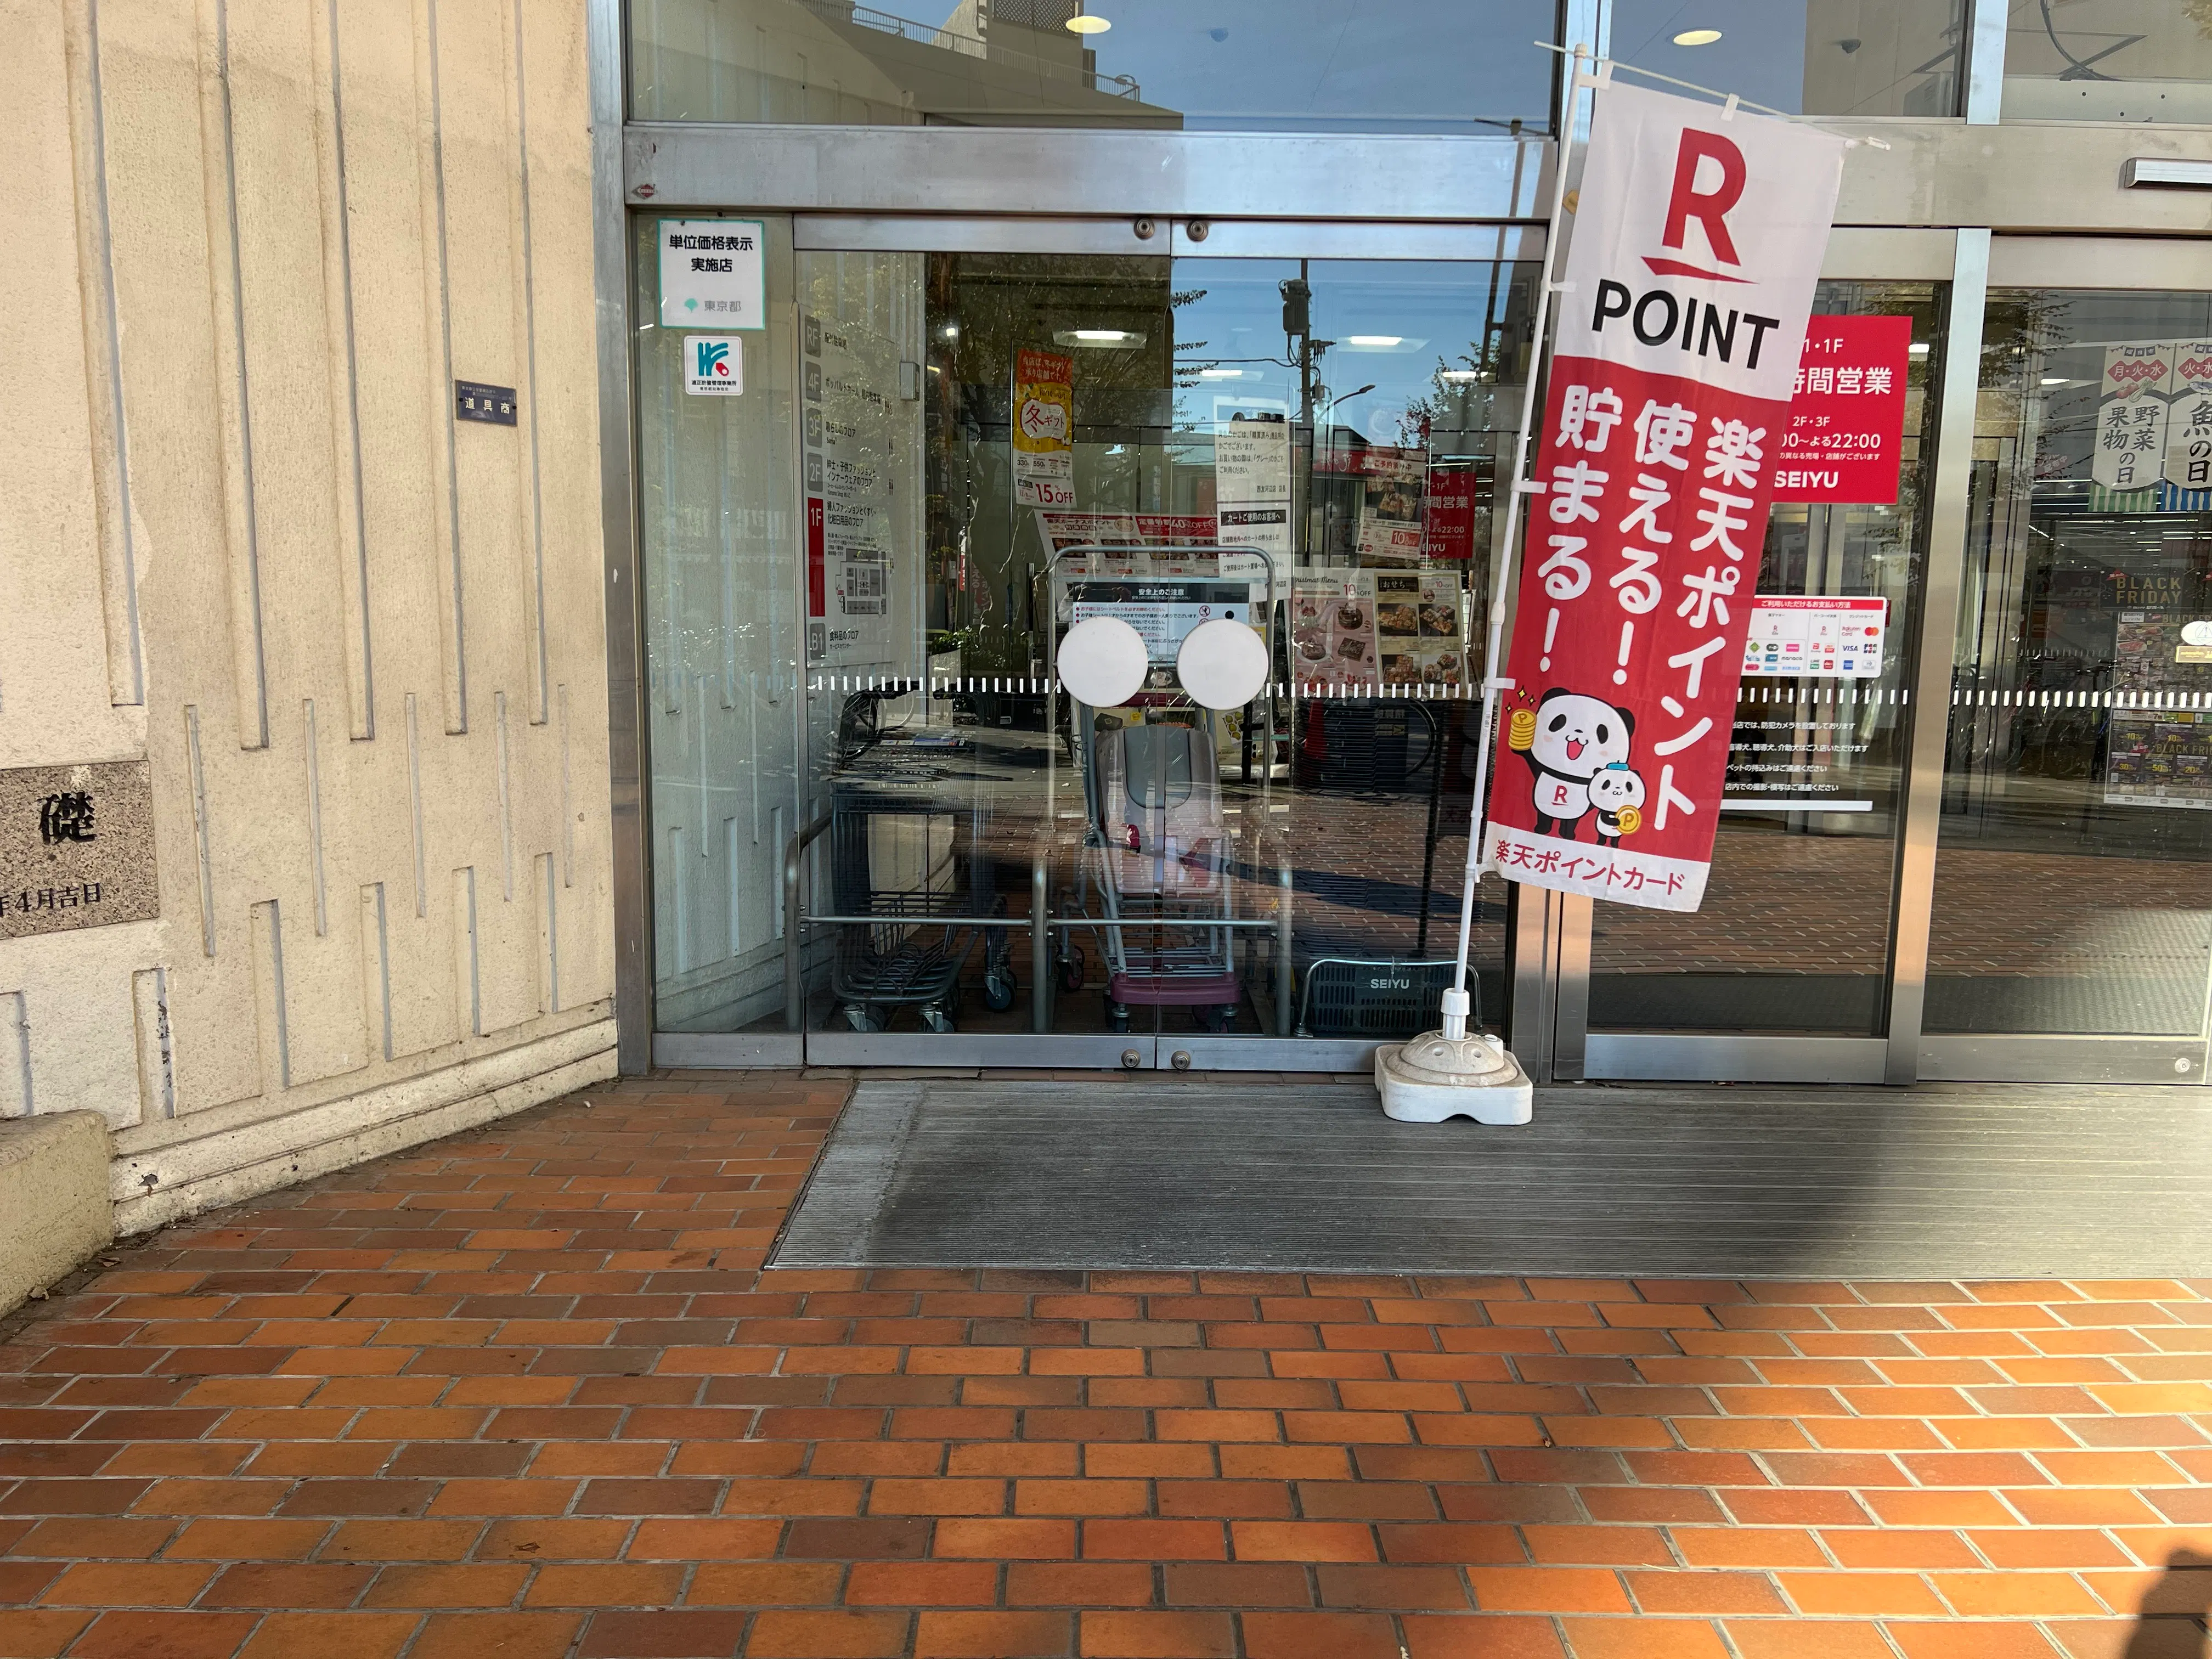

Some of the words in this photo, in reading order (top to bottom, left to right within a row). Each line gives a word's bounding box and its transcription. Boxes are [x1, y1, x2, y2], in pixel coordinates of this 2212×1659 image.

[1662, 127, 1747, 267] R
[669, 235, 753, 251] 単位価格表示
[691, 257, 732, 272] 実施店
[704, 301, 741, 312] 東京都
[1592, 278, 1780, 370] POINT
[807, 326, 819, 347] RF
[2114, 364, 2162, 376] 月・火・水
[808, 373, 819, 392] 4F
[465, 397, 510, 414] 道具商
[809, 416, 821, 437] 3F
[2103, 407, 2130, 450] 果物
[2133, 405, 2160, 451] 野菜
[810, 462, 821, 482] 2F
[1774, 470, 1838, 488] SEIYU
[811, 507, 822, 526] 1F
[827, 513, 864, 527] 化粧日用品のフロア
[1228, 512, 1280, 522] カートご使用のお客様へ
[1538, 385, 1623, 673] 貯まる！
[1610, 399, 1697, 685] 使える！
[2117, 577, 2181, 590] BLACK
[1761, 600, 1851, 608] ご利用いただけるお支払い方法
[2117, 591, 2181, 604] FRIDAY
[1653, 417, 1767, 830] 楽天ポイント
[812, 633, 823, 651] B1
[830, 630, 859, 641] 食料品のフロア
[2156, 744, 2188, 754] BLACK
[1554, 785, 1567, 803] R
[1496, 839, 1685, 896] 楽天ポイントカード
[1370, 979, 1409, 989] SEIYU
